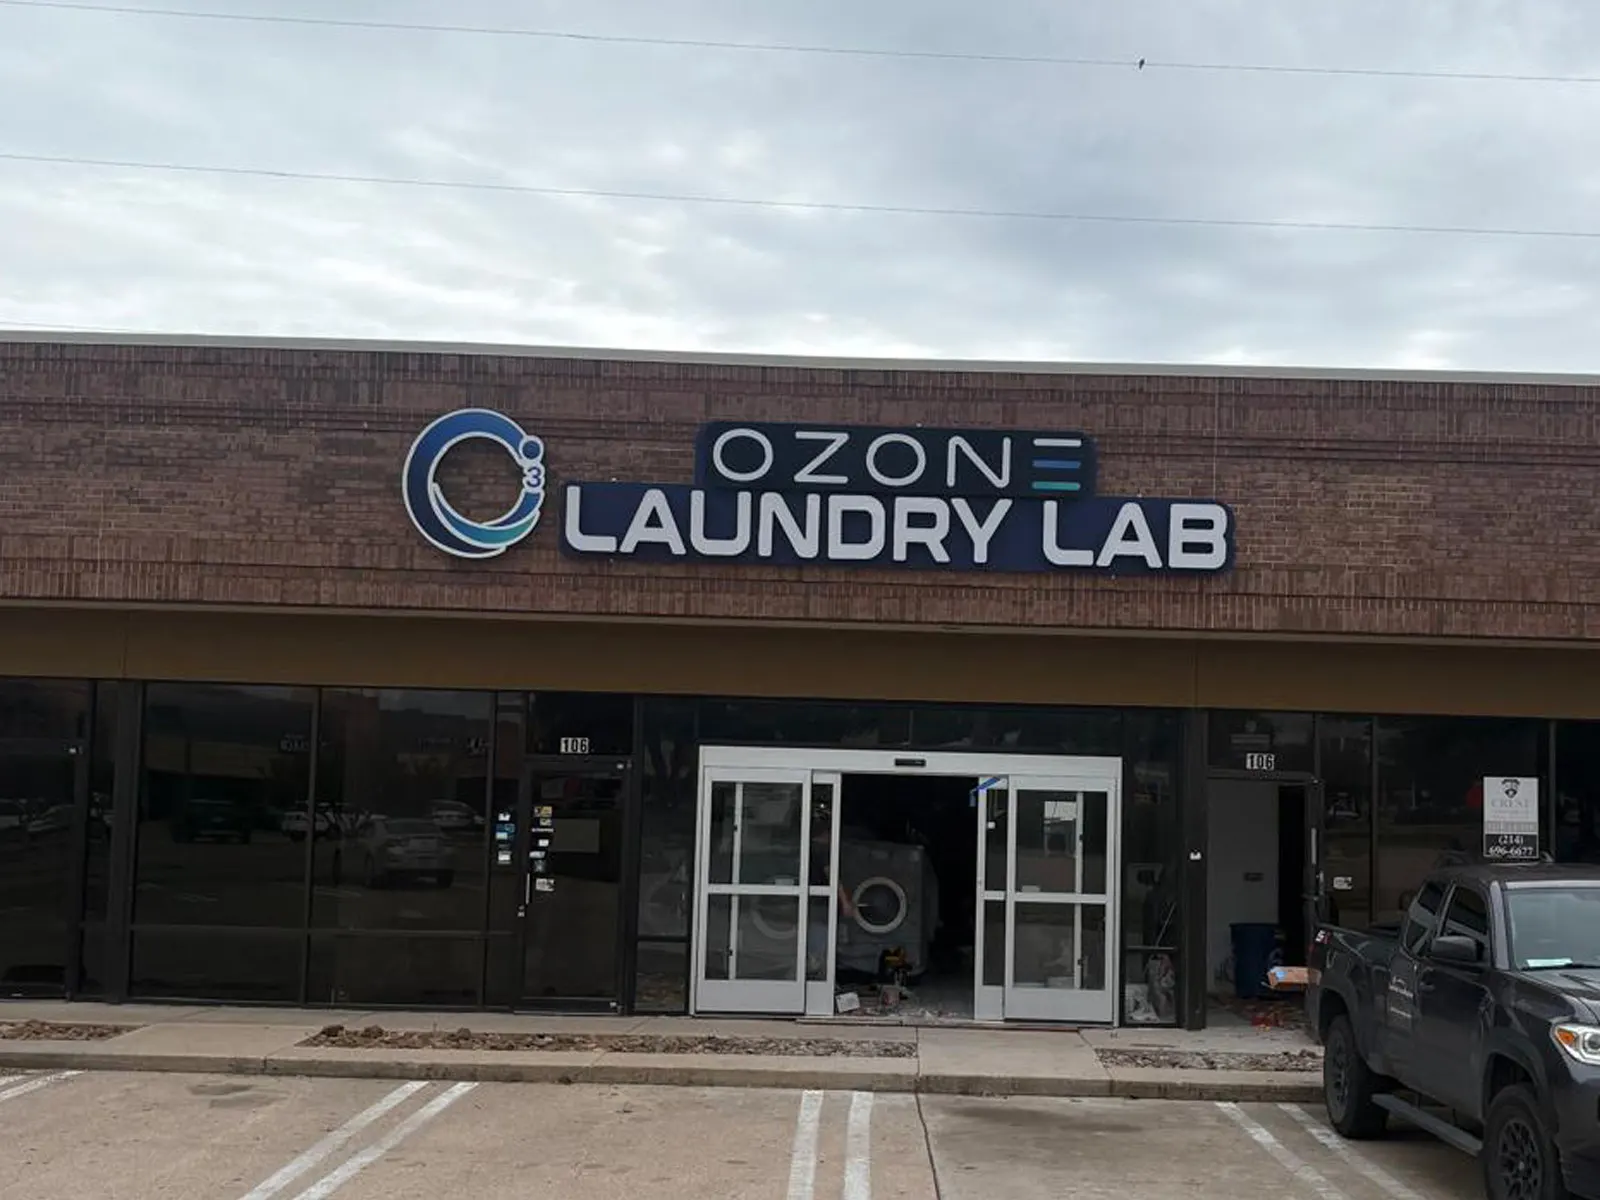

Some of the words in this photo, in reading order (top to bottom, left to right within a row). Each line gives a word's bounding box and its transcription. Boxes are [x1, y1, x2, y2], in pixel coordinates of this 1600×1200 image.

[713, 428, 1082, 492] OZONE
[565, 485, 1013, 564] LAUNDRY
[1042, 501, 1228, 570] LAB
[561, 738, 588, 752] 106
[1246, 753, 1274, 770] 106
